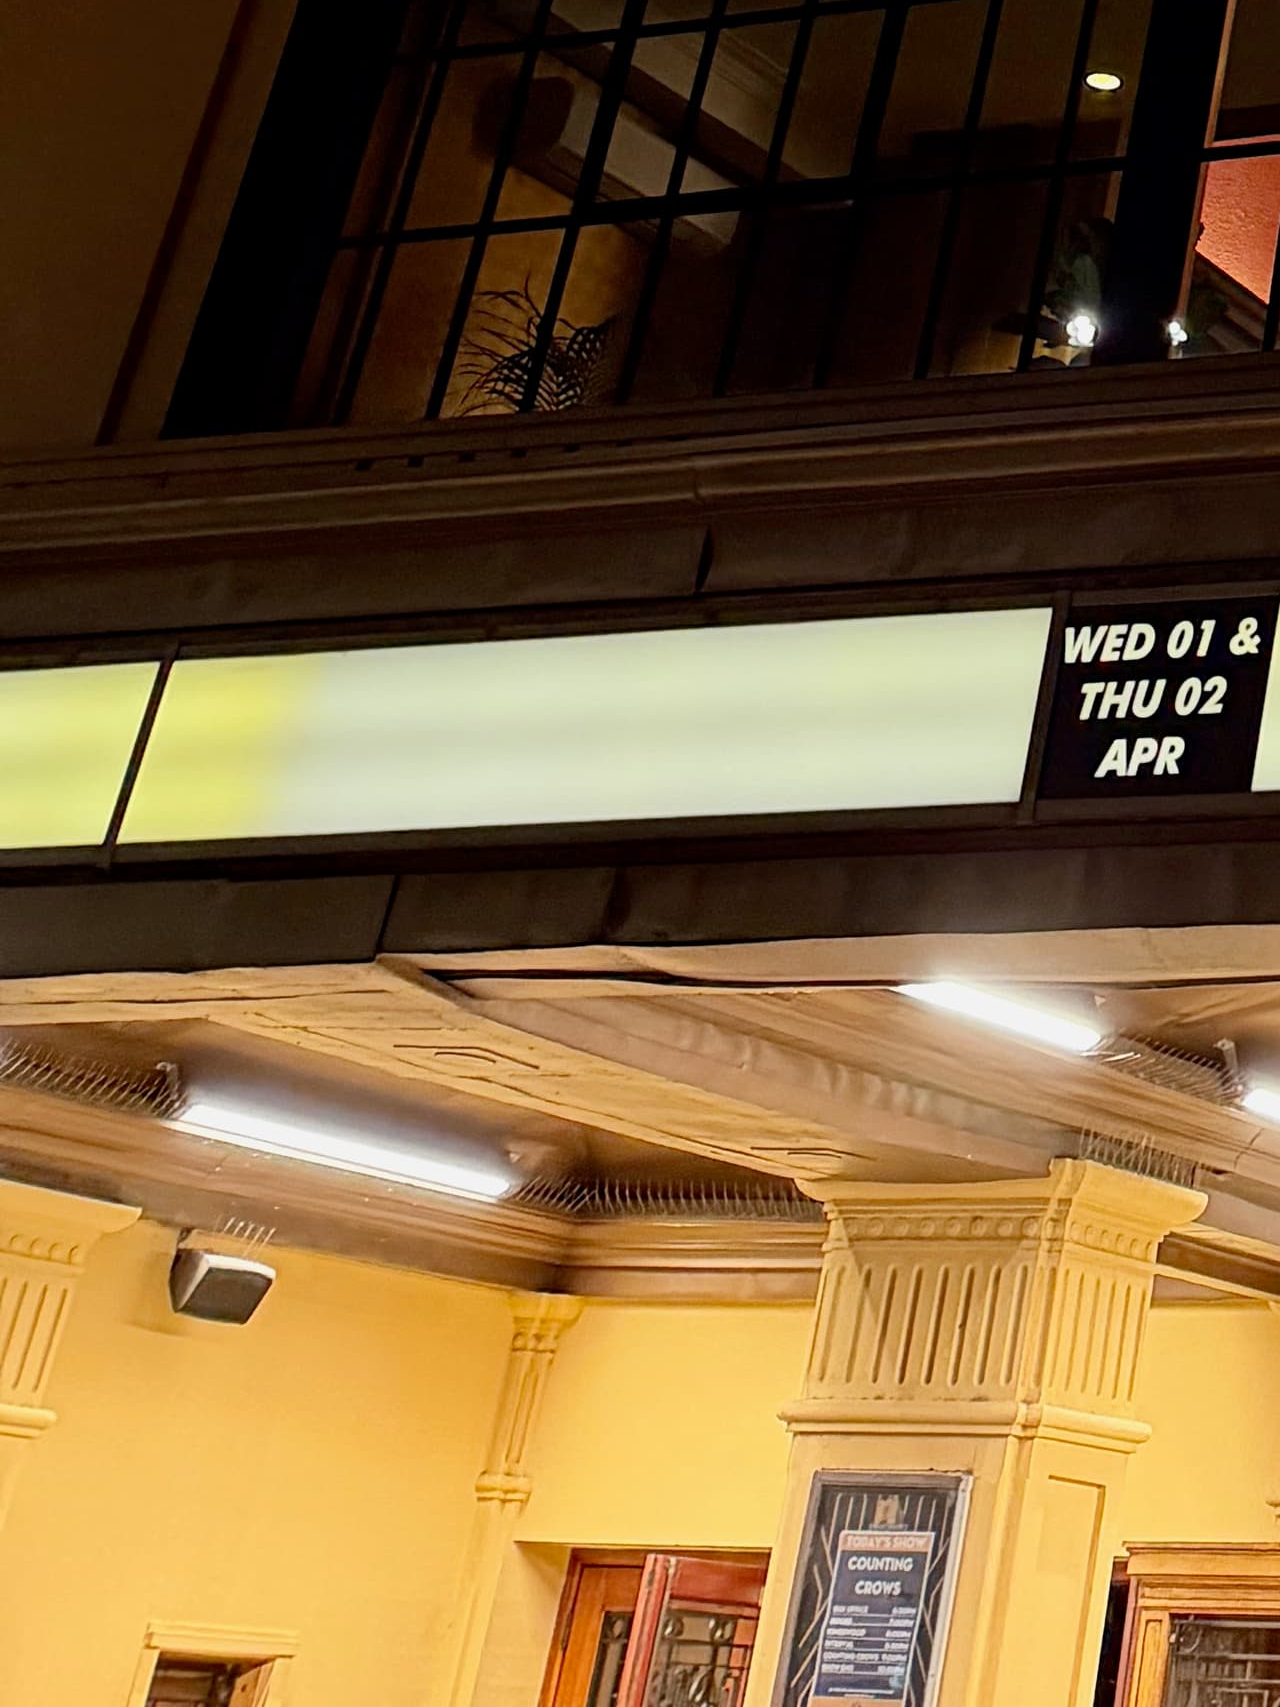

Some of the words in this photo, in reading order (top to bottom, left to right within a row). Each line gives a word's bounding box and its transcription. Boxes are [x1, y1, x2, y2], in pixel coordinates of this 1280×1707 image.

[1064, 623, 1156, 664] WED
[1166, 619, 1216, 659] 01
[1229, 617, 1261, 656] &
[1079, 678, 1167, 721] THU
[1174, 675, 1228, 716] 02
[1094, 736, 1186, 778] APR
[847, 1555, 914, 1572] COUNTING
[854, 1579, 902, 1596] CROWS
